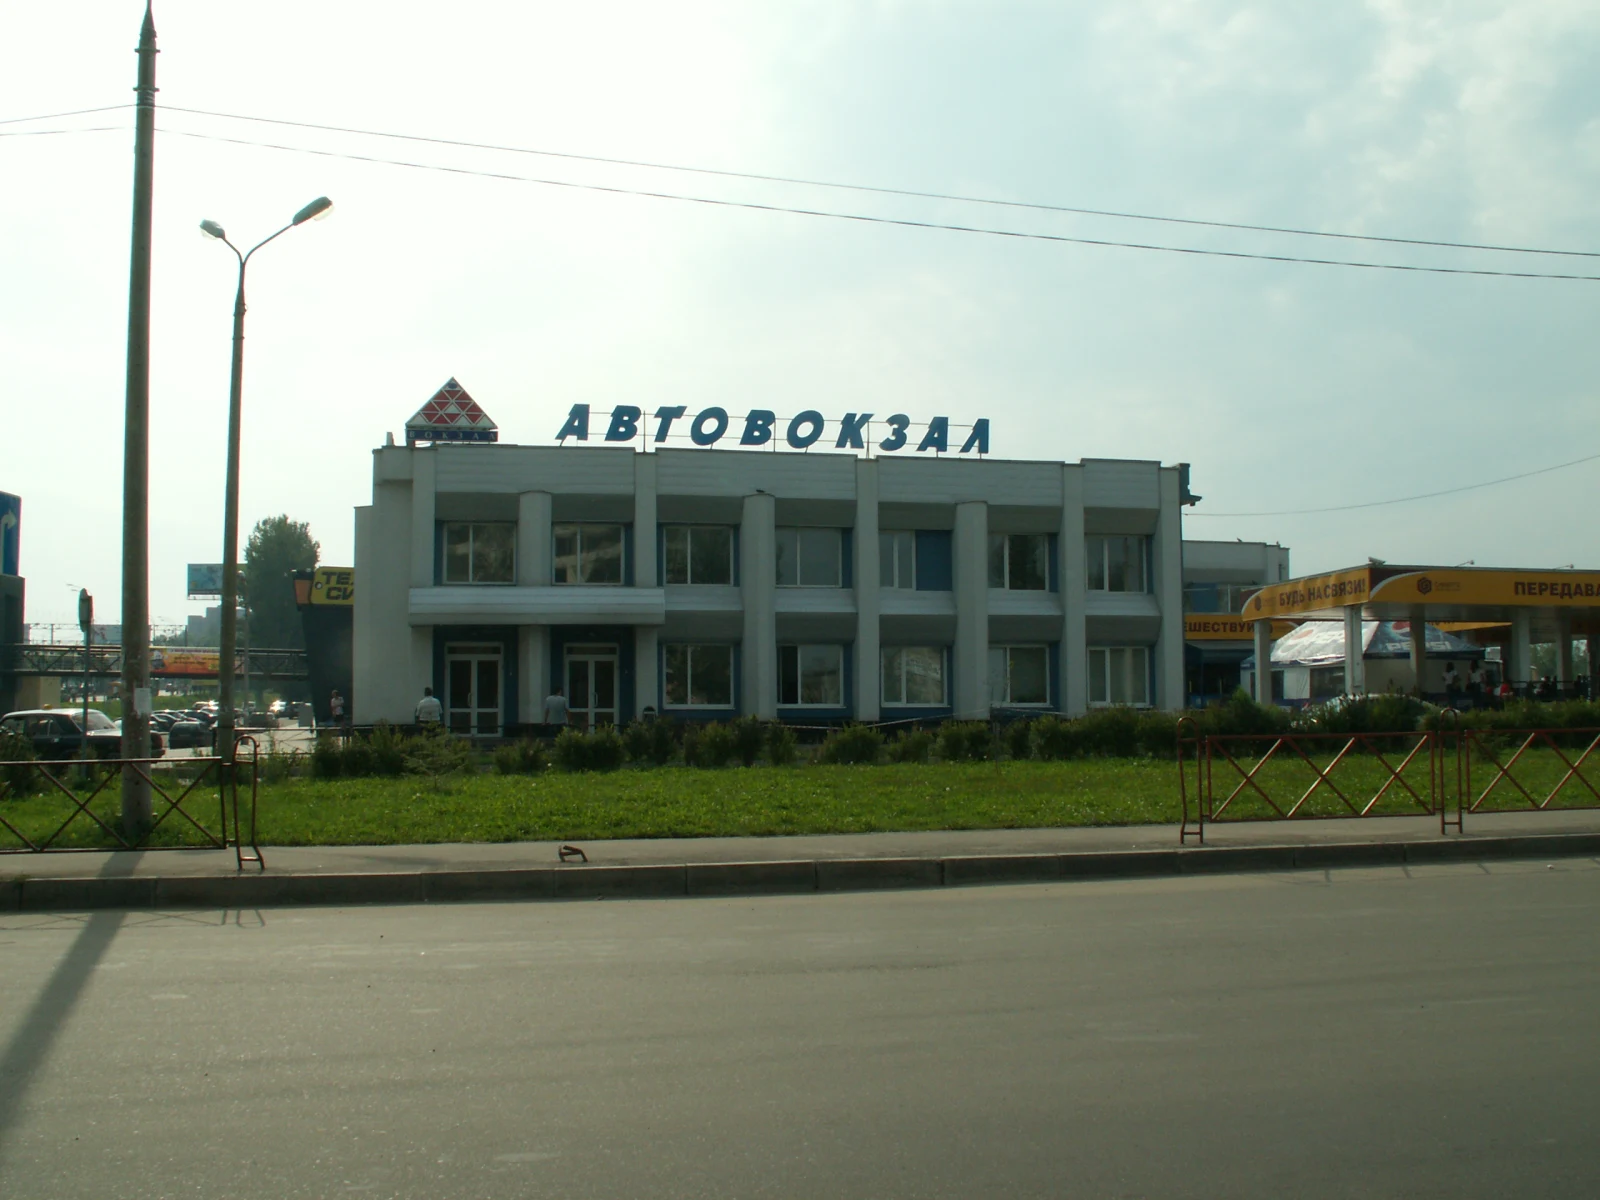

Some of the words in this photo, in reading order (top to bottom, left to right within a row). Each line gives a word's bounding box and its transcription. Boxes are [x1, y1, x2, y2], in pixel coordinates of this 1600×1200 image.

[409, 431, 496, 440] ВОКЗАЛ
[554, 403, 989, 454] АВТОВОКЗАЛ
[322, 571, 354, 585] ТЕ
[1280, 589, 1305, 607] БУДЬ
[1385, 641, 1452, 651] PESI
